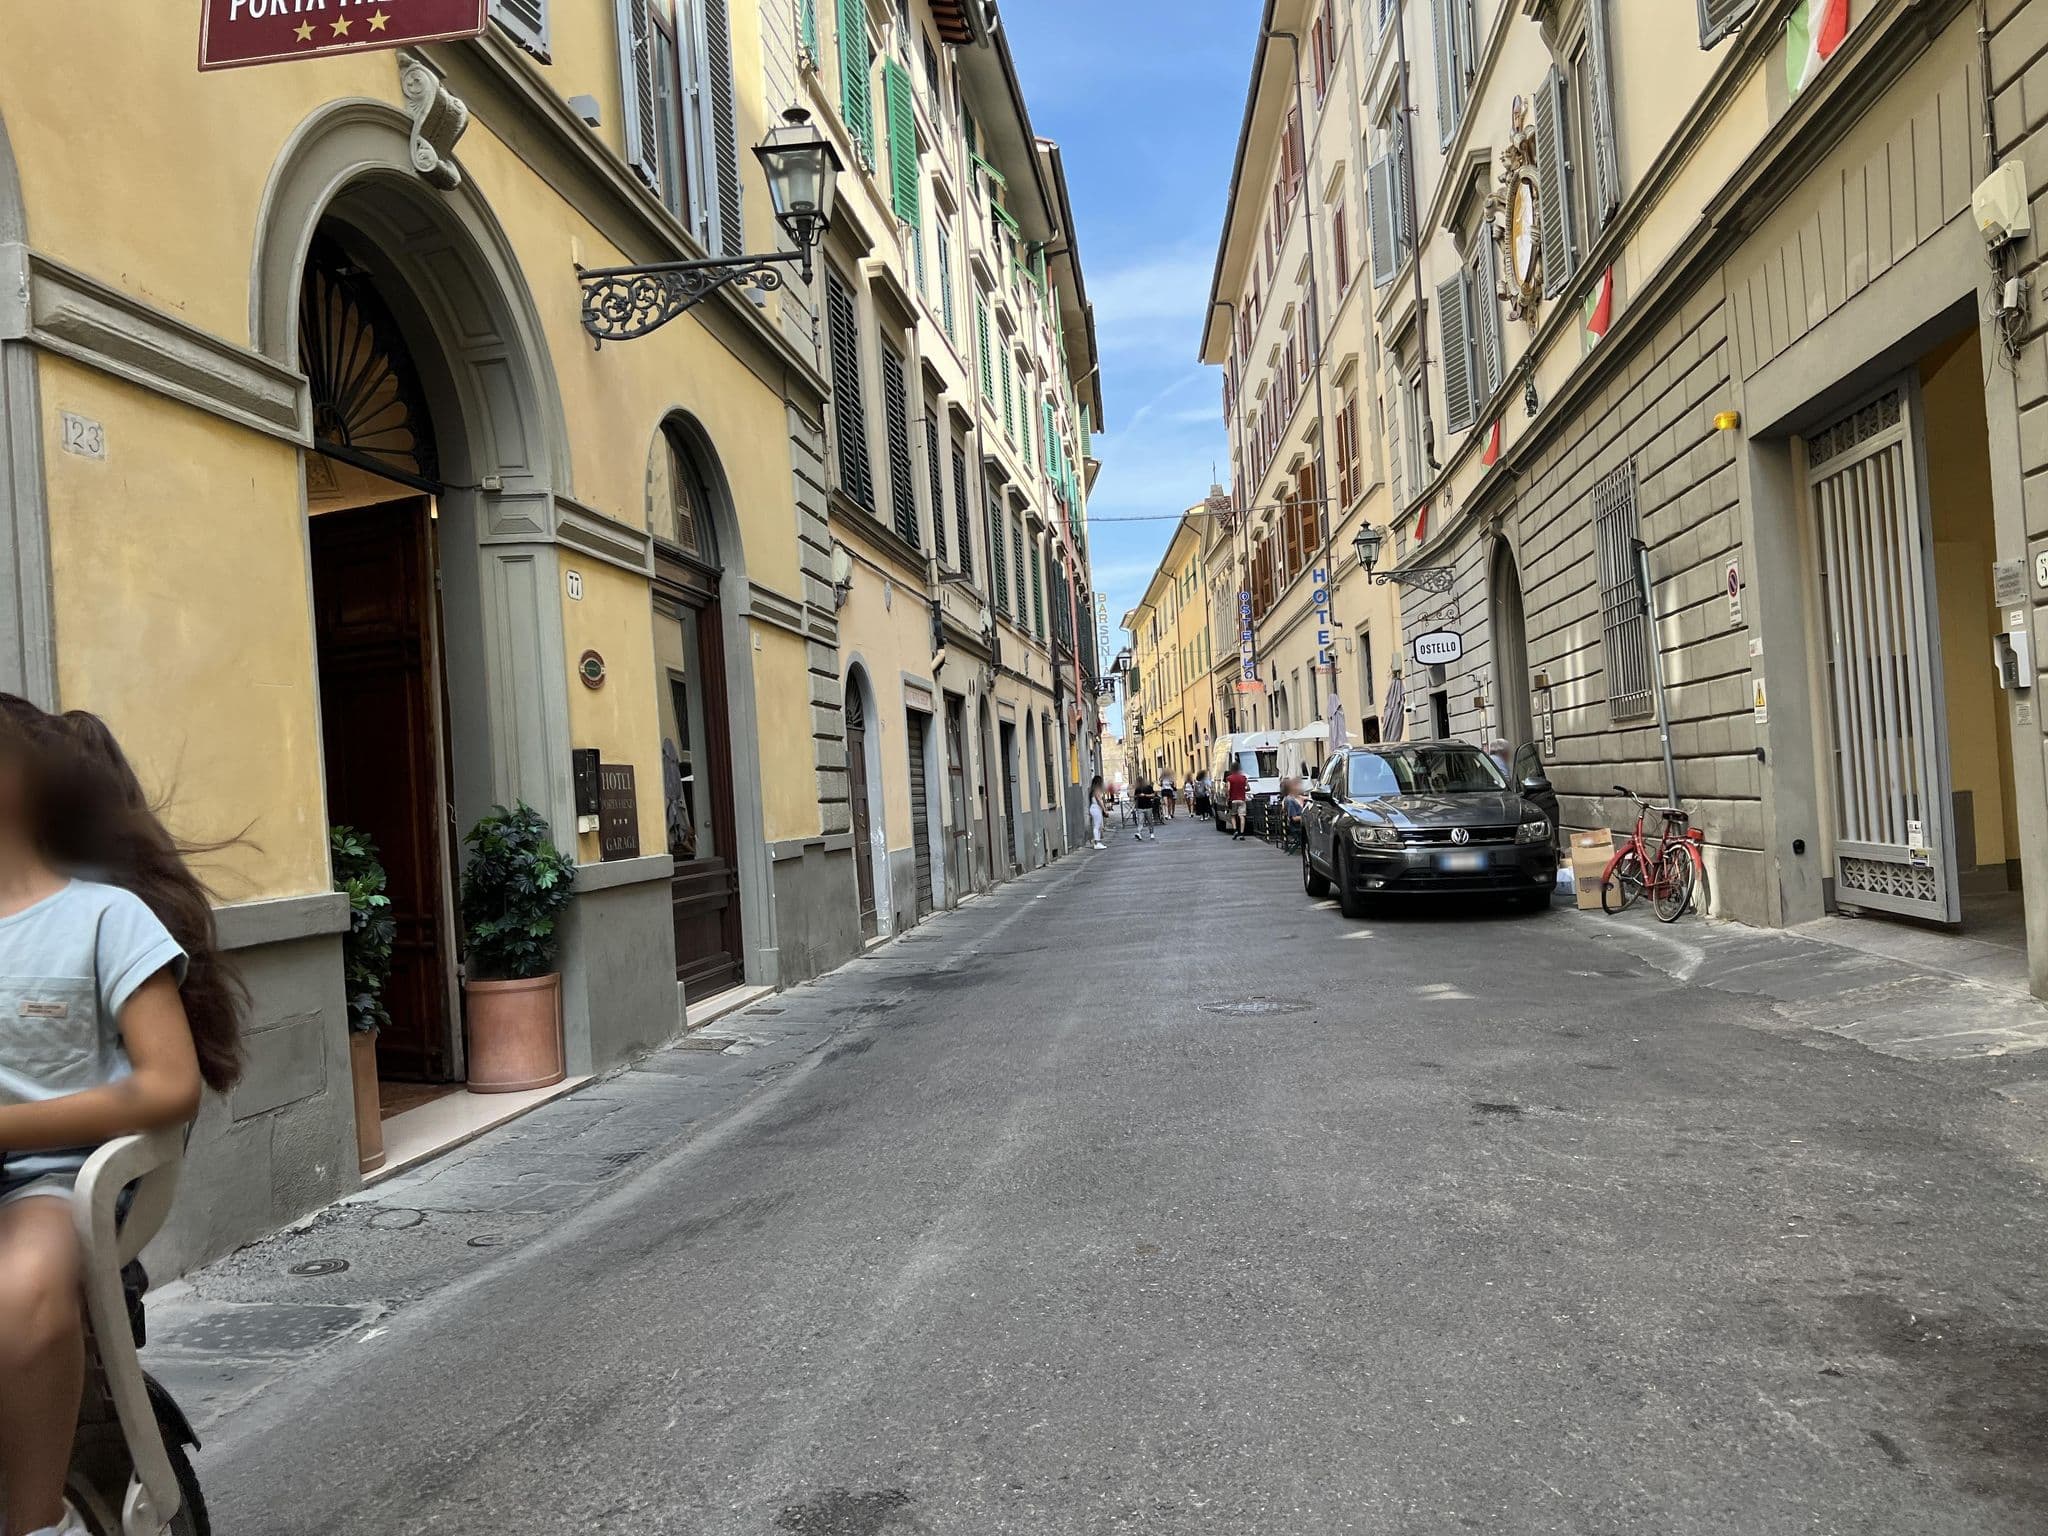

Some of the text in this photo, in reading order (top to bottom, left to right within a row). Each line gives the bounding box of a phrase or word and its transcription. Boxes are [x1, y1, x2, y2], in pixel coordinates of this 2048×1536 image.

[64, 417, 101, 453] 123
[1312, 567, 1331, 664] HOTEL
[1239, 591, 1254, 680] OSTELLO
[1420, 641, 1456, 655] OSTELLO
[601, 771, 632, 791] HOTEL
[605, 835, 637, 851] GARAGE
